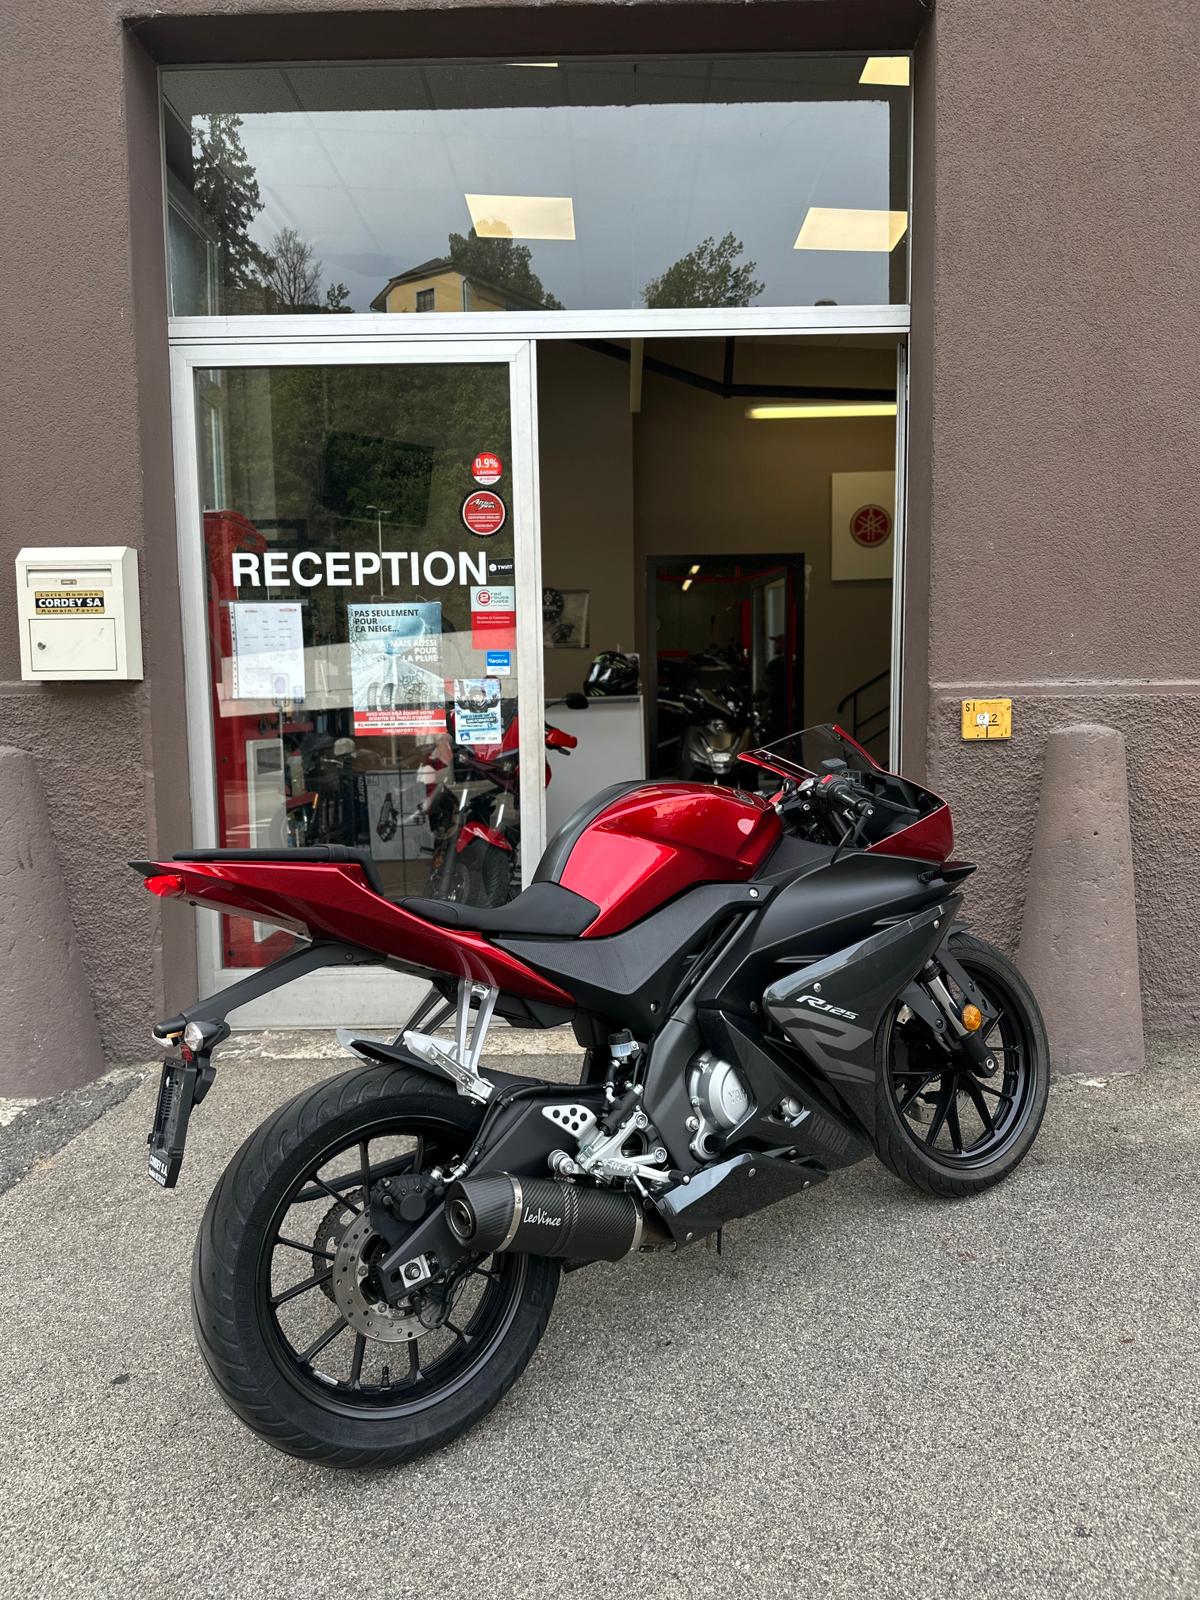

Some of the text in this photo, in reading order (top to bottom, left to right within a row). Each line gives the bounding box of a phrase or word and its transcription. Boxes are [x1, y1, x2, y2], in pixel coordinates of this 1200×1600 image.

[475, 458, 499, 468] 0.9%
[231, 550, 488, 587] RECEPTION
[38, 597, 102, 607] CORDEY SA
[371, 609, 420, 617] SEULEMENT
[354, 617, 378, 625] POUR
[355, 625, 366, 633] LA
[391, 639, 437, 647] MAIS AUSSI
[414, 647, 438, 655] POUR
[415, 654, 438, 662] PLUIE
[523, 1206, 562, 1226] LeoVince
